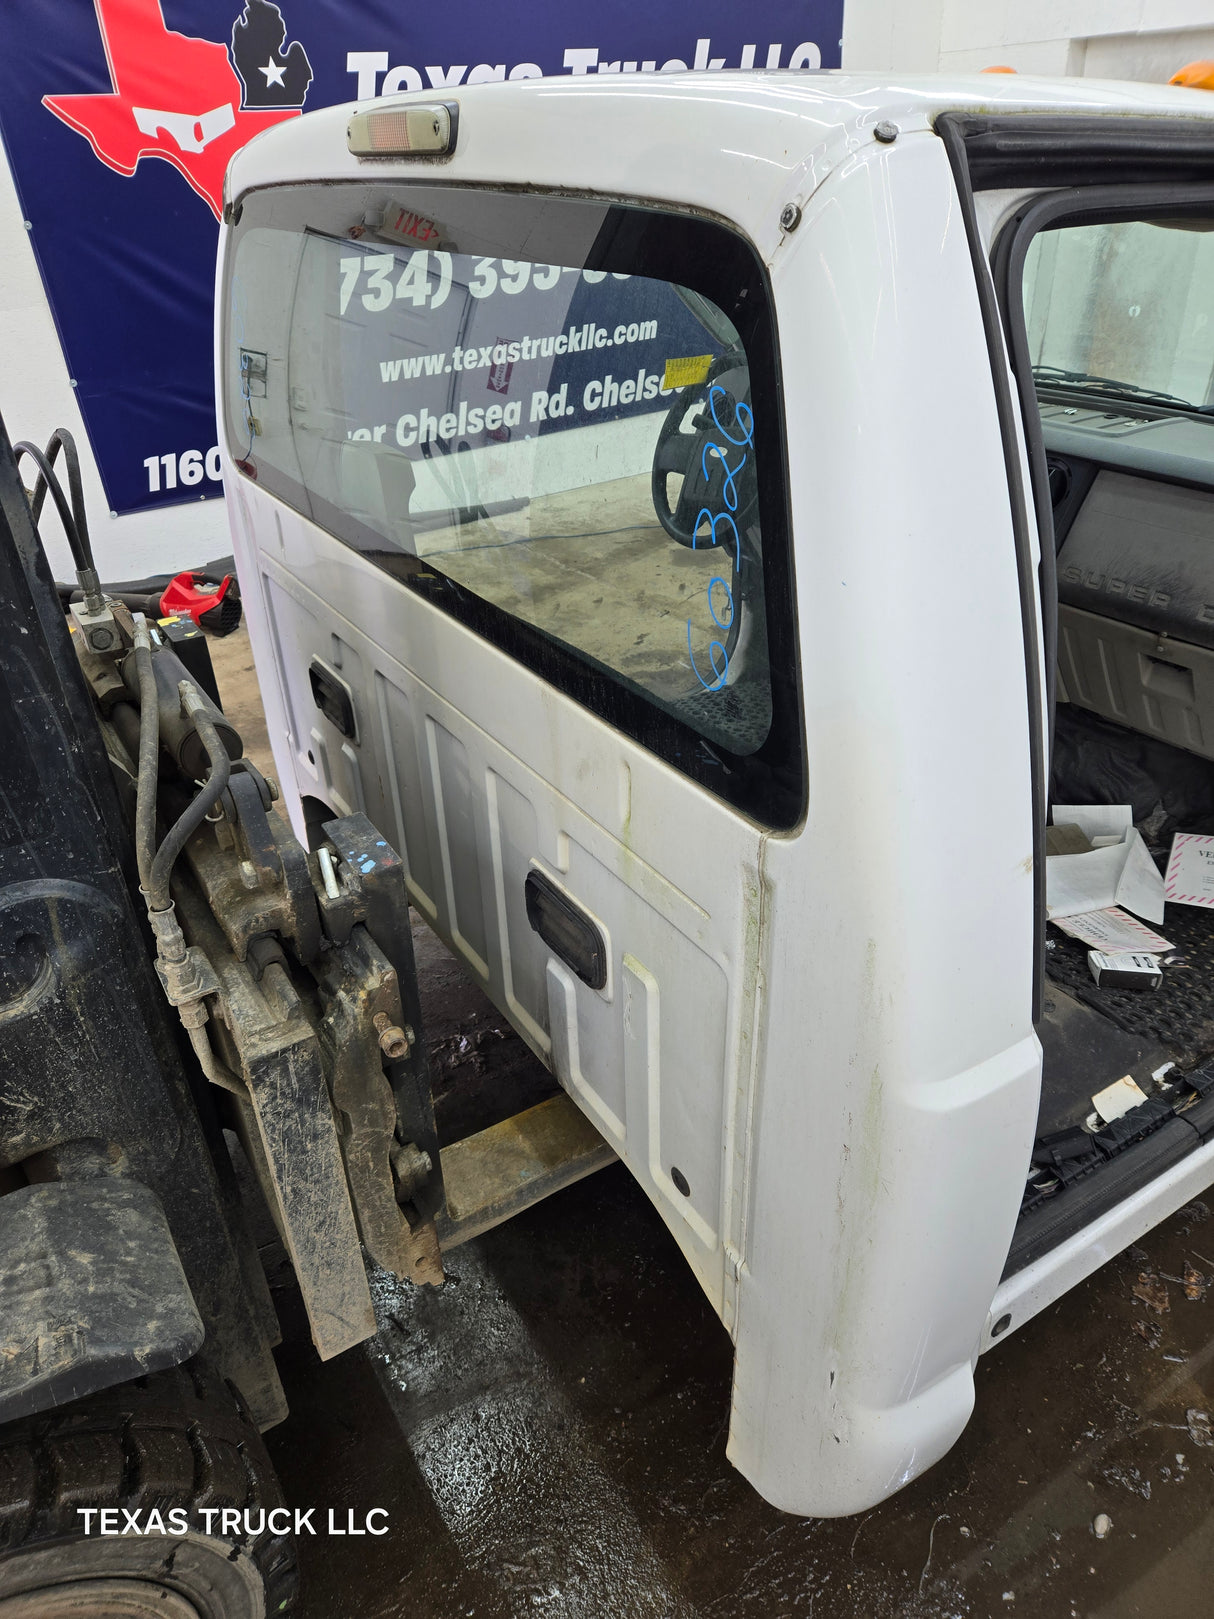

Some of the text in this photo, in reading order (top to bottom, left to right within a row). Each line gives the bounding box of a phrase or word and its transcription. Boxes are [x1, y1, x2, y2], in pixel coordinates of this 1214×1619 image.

[380, 319, 658, 383] www.texastruckllc.com
[395, 401, 522, 447] Chelsea
[529, 383, 575, 423] Rd.
[583, 368, 685, 412] Chels
[1062, 566, 1172, 611] SUPER
